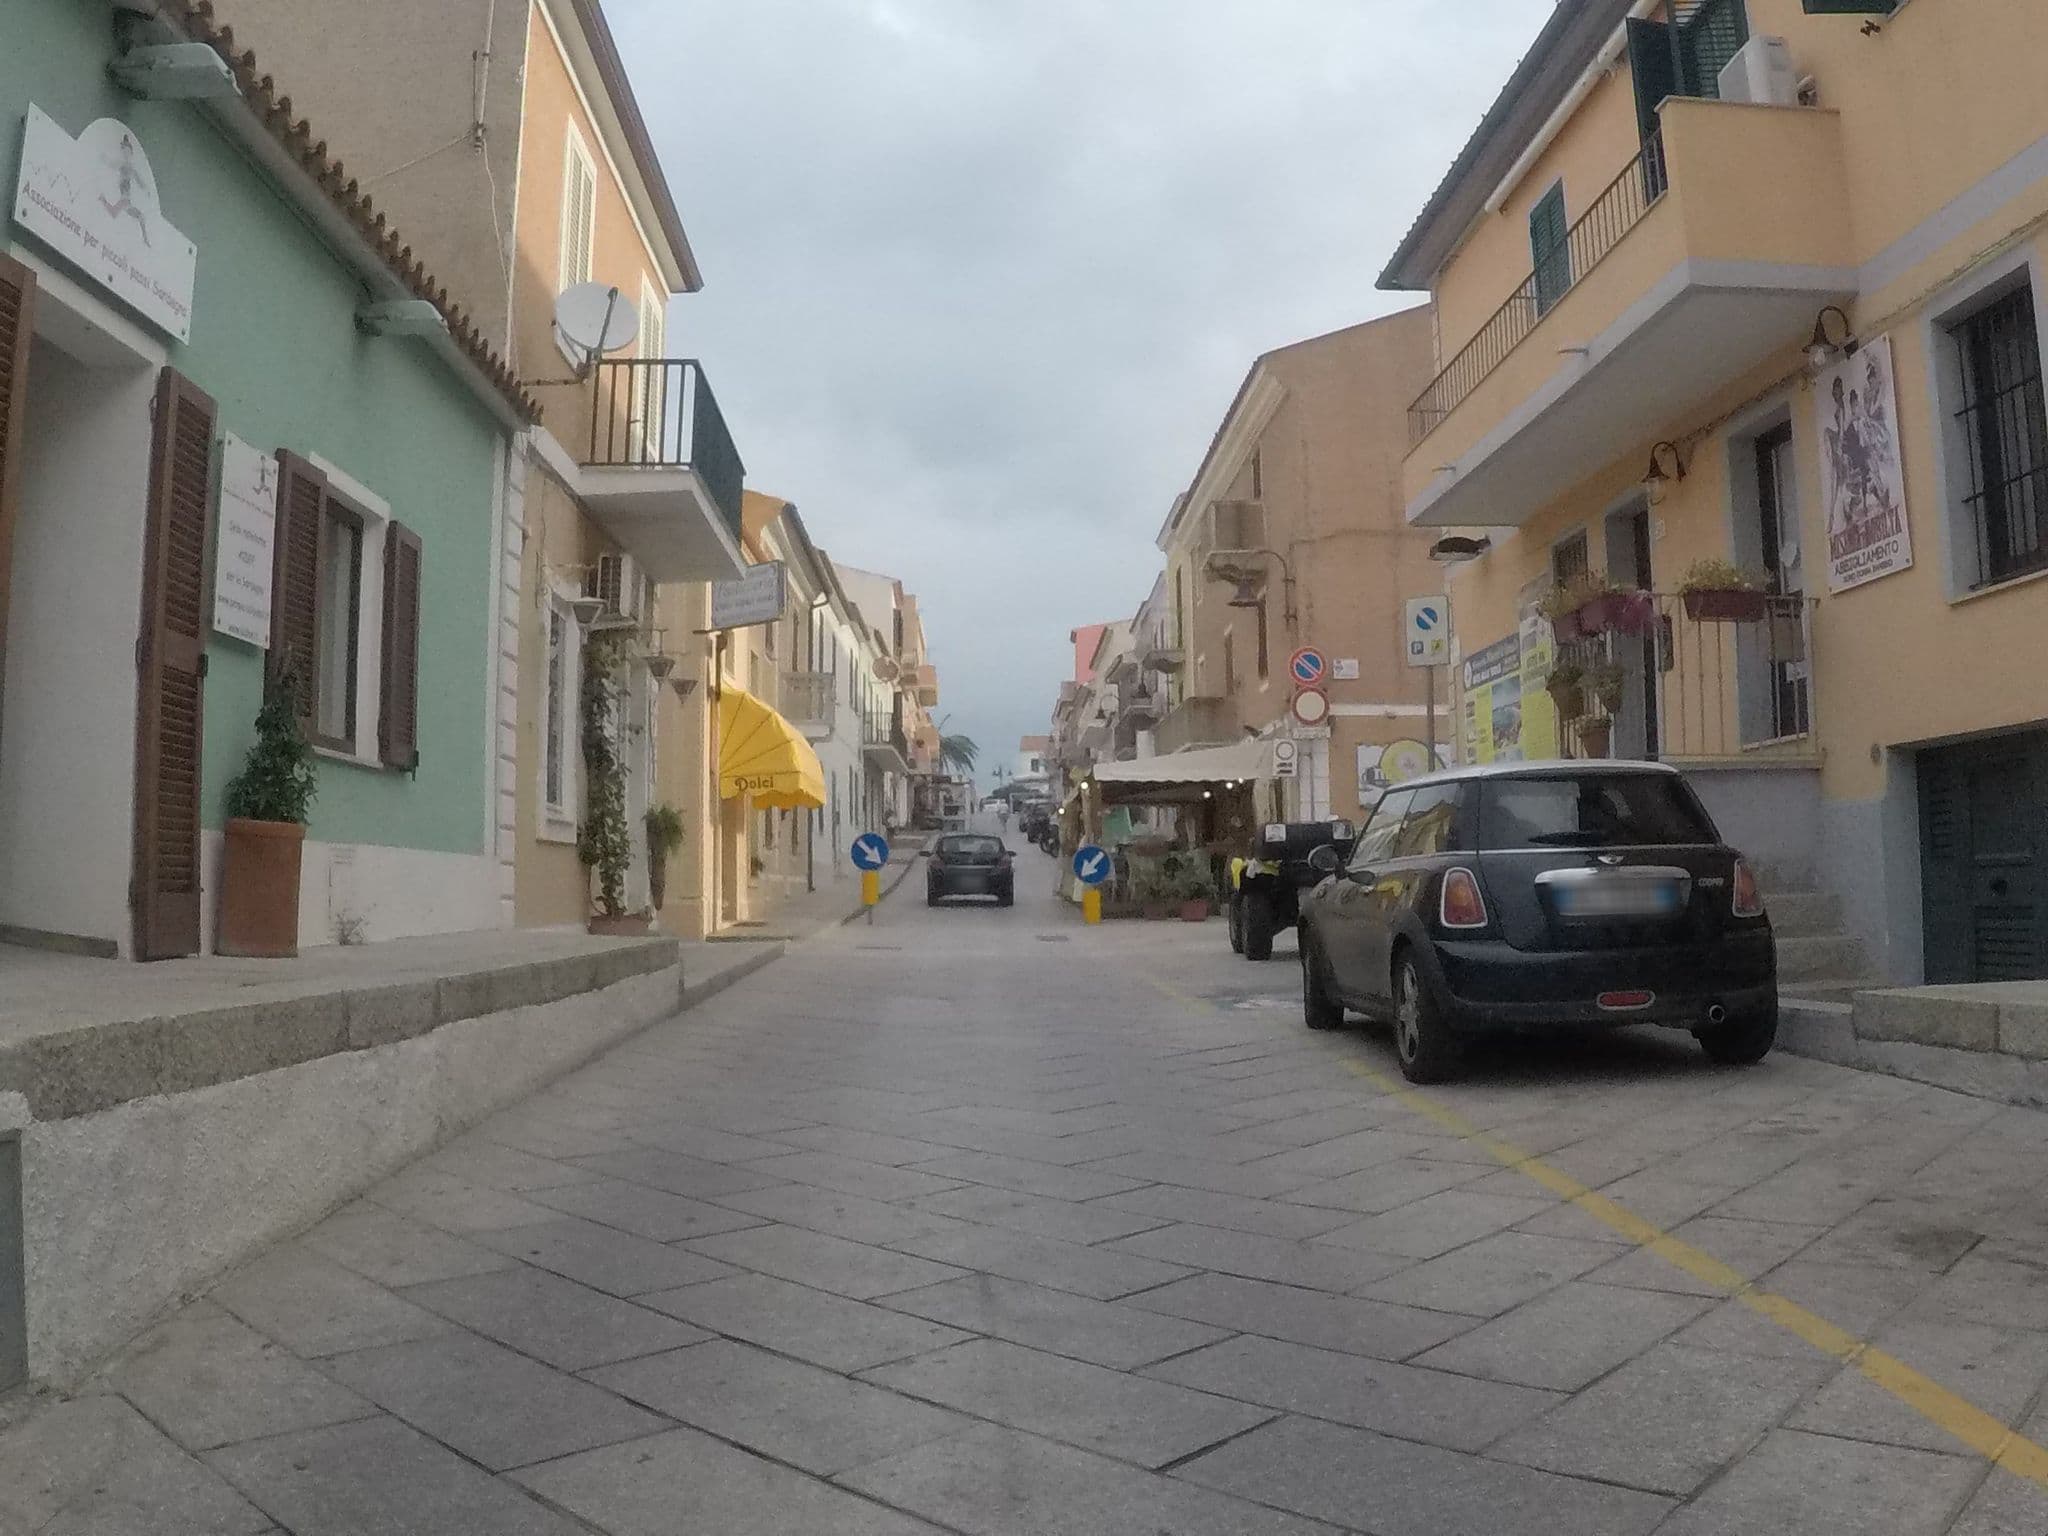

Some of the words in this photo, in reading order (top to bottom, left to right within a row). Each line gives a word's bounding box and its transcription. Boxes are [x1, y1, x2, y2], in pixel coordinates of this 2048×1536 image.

[22, 180, 82, 236] Associazione
[83, 229, 99, 249] per
[734, 776, 774, 792] Dolci
